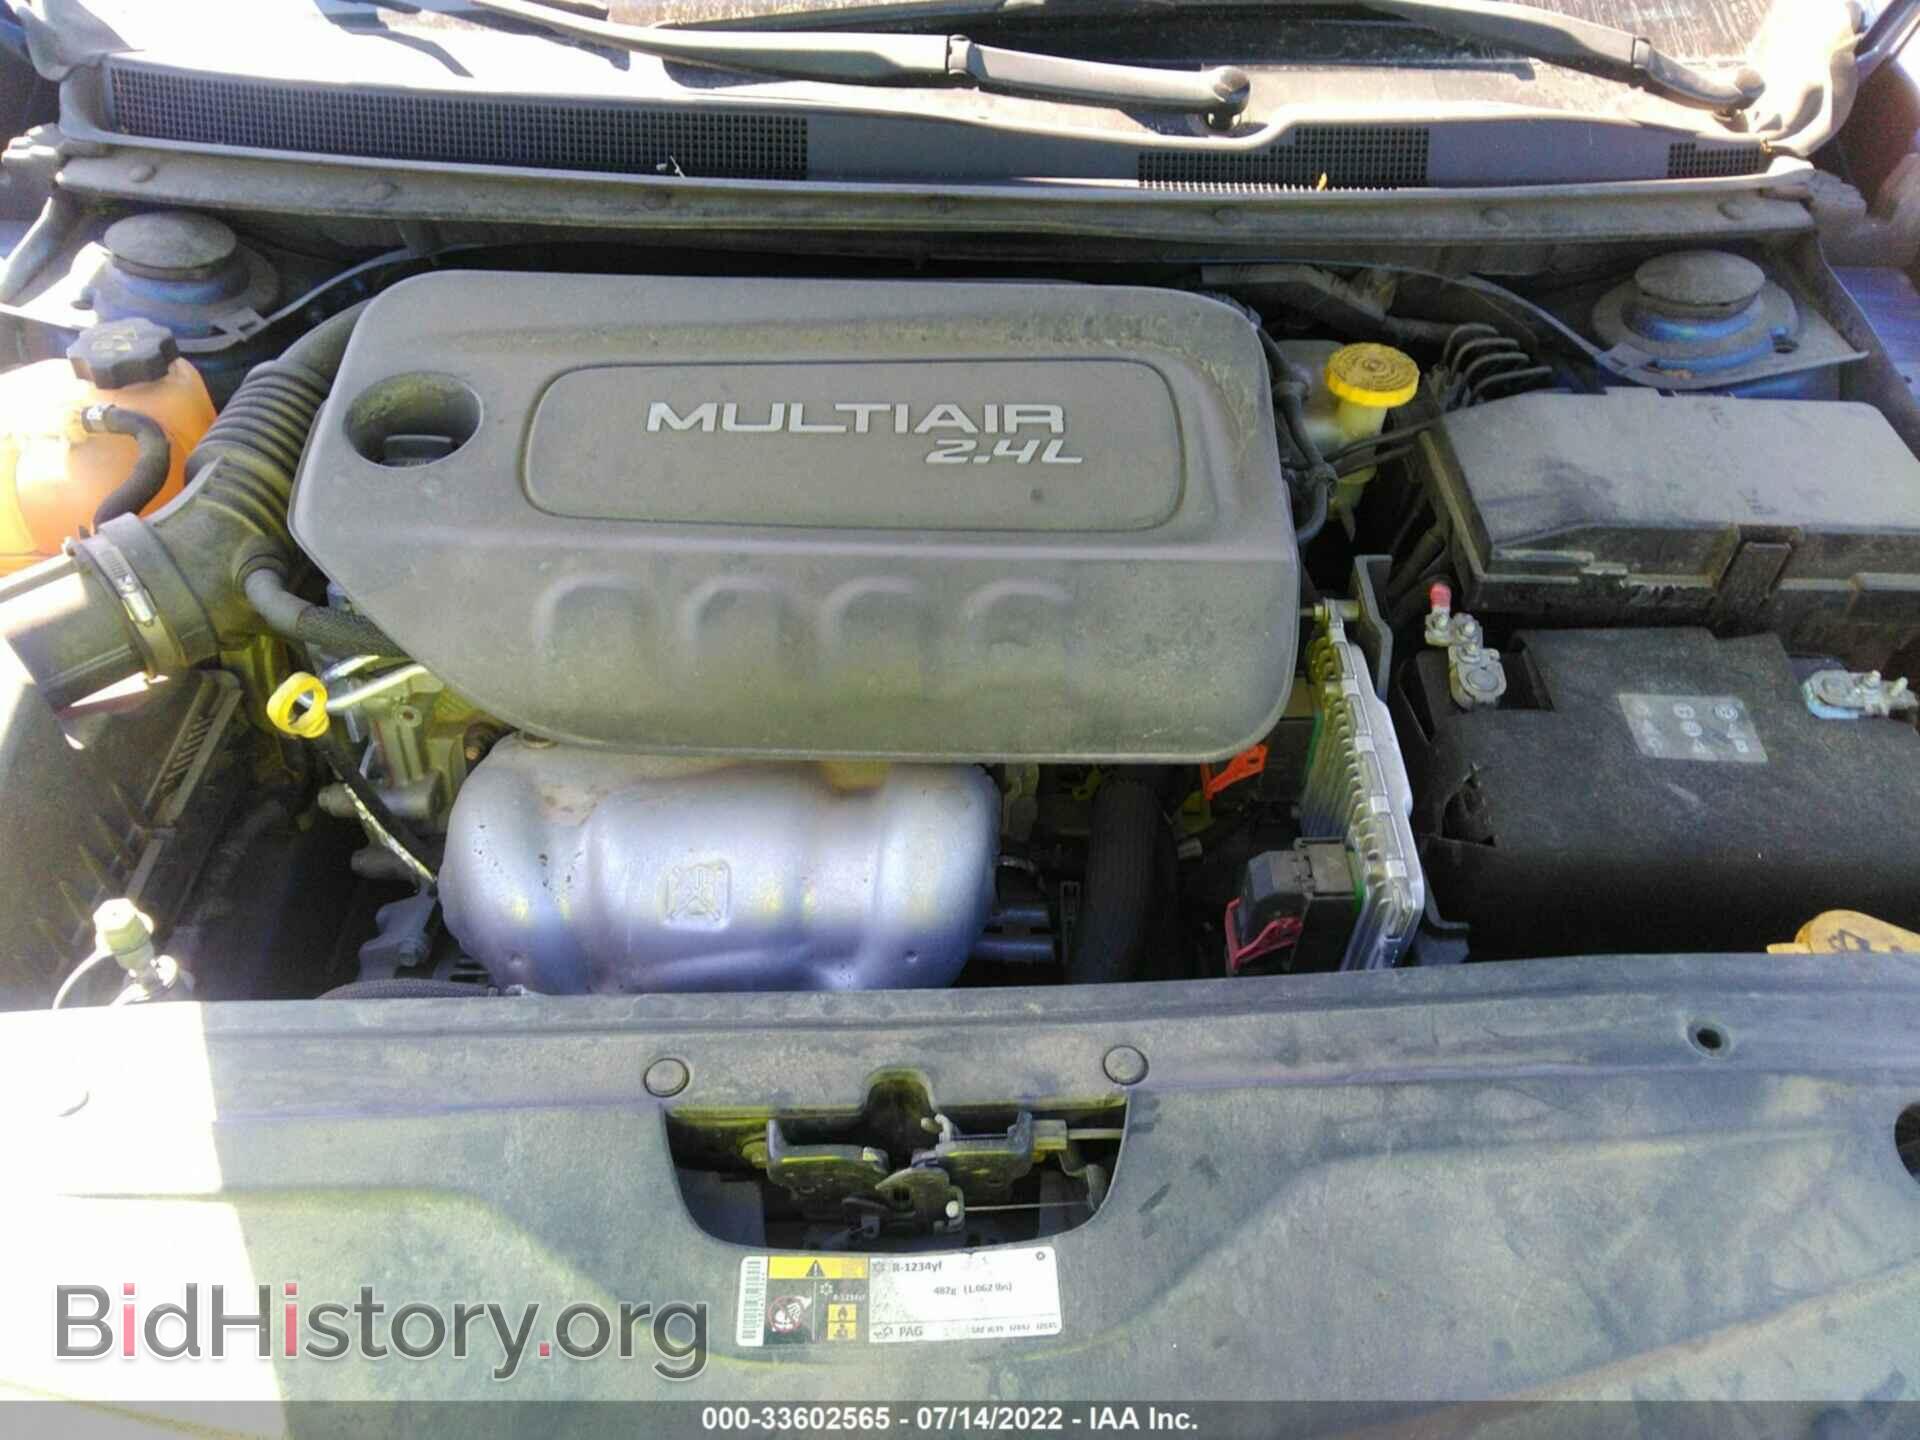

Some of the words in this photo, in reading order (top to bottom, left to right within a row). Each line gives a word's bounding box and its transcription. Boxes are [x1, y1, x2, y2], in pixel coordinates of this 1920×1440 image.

[646, 402, 1065, 433] MULTIAIR
[925, 439, 1083, 464] 2.4L
[899, 1325, 924, 1337] PAG
